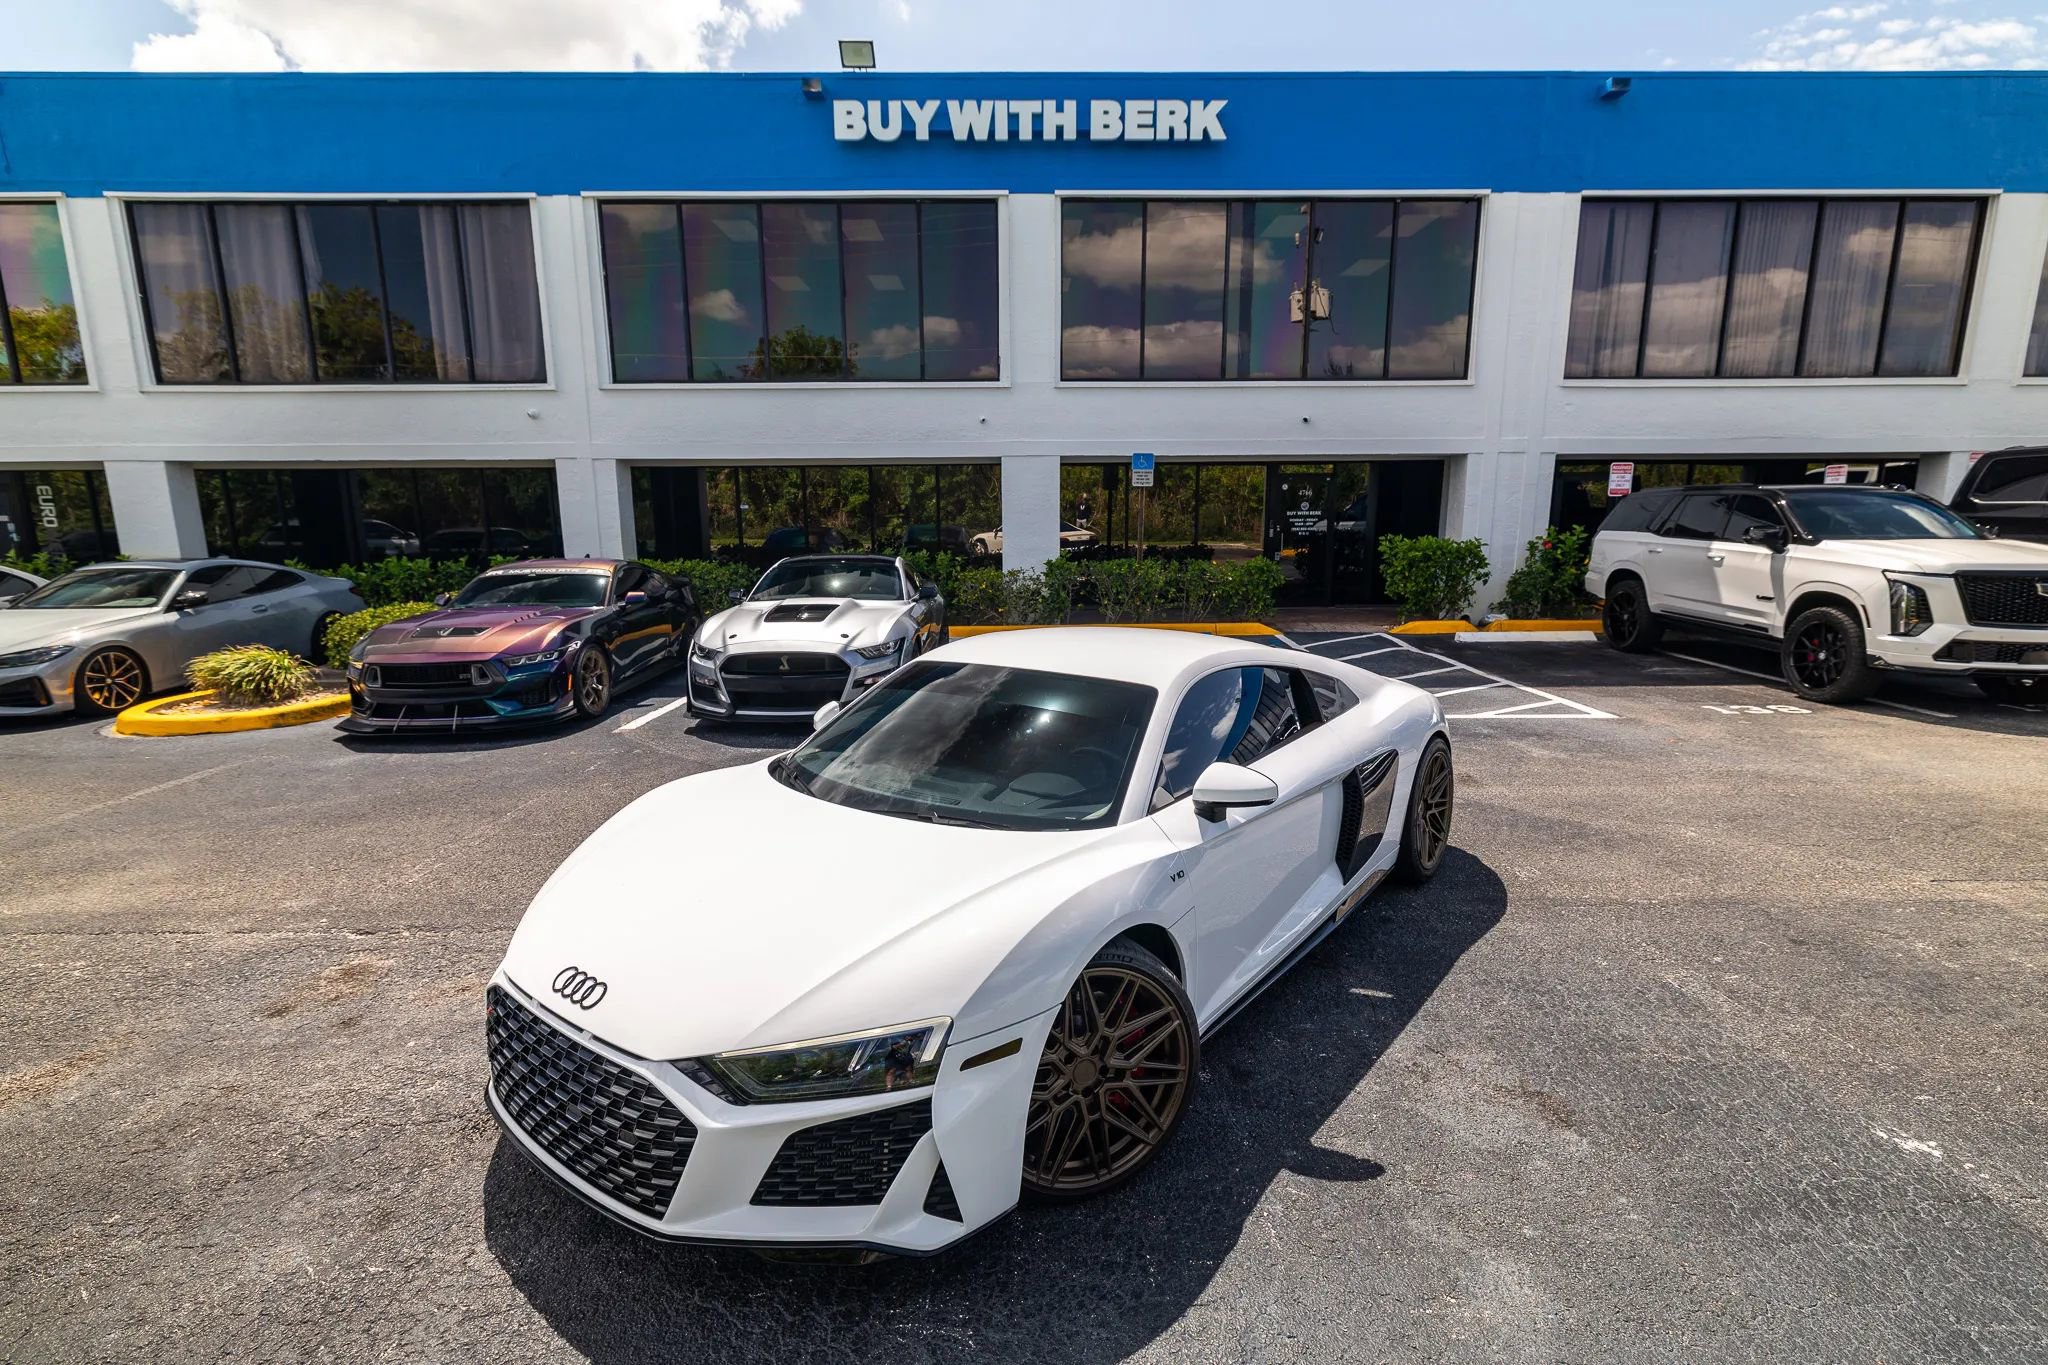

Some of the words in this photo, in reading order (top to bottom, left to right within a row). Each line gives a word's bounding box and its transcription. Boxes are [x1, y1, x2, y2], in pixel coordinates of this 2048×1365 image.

[833, 99, 940, 142] BUY
[946, 99, 1077, 142] WITH
[1090, 99, 1228, 142] BERK
[36, 485, 58, 528] EURO
[1701, 705, 1812, 714] 138
